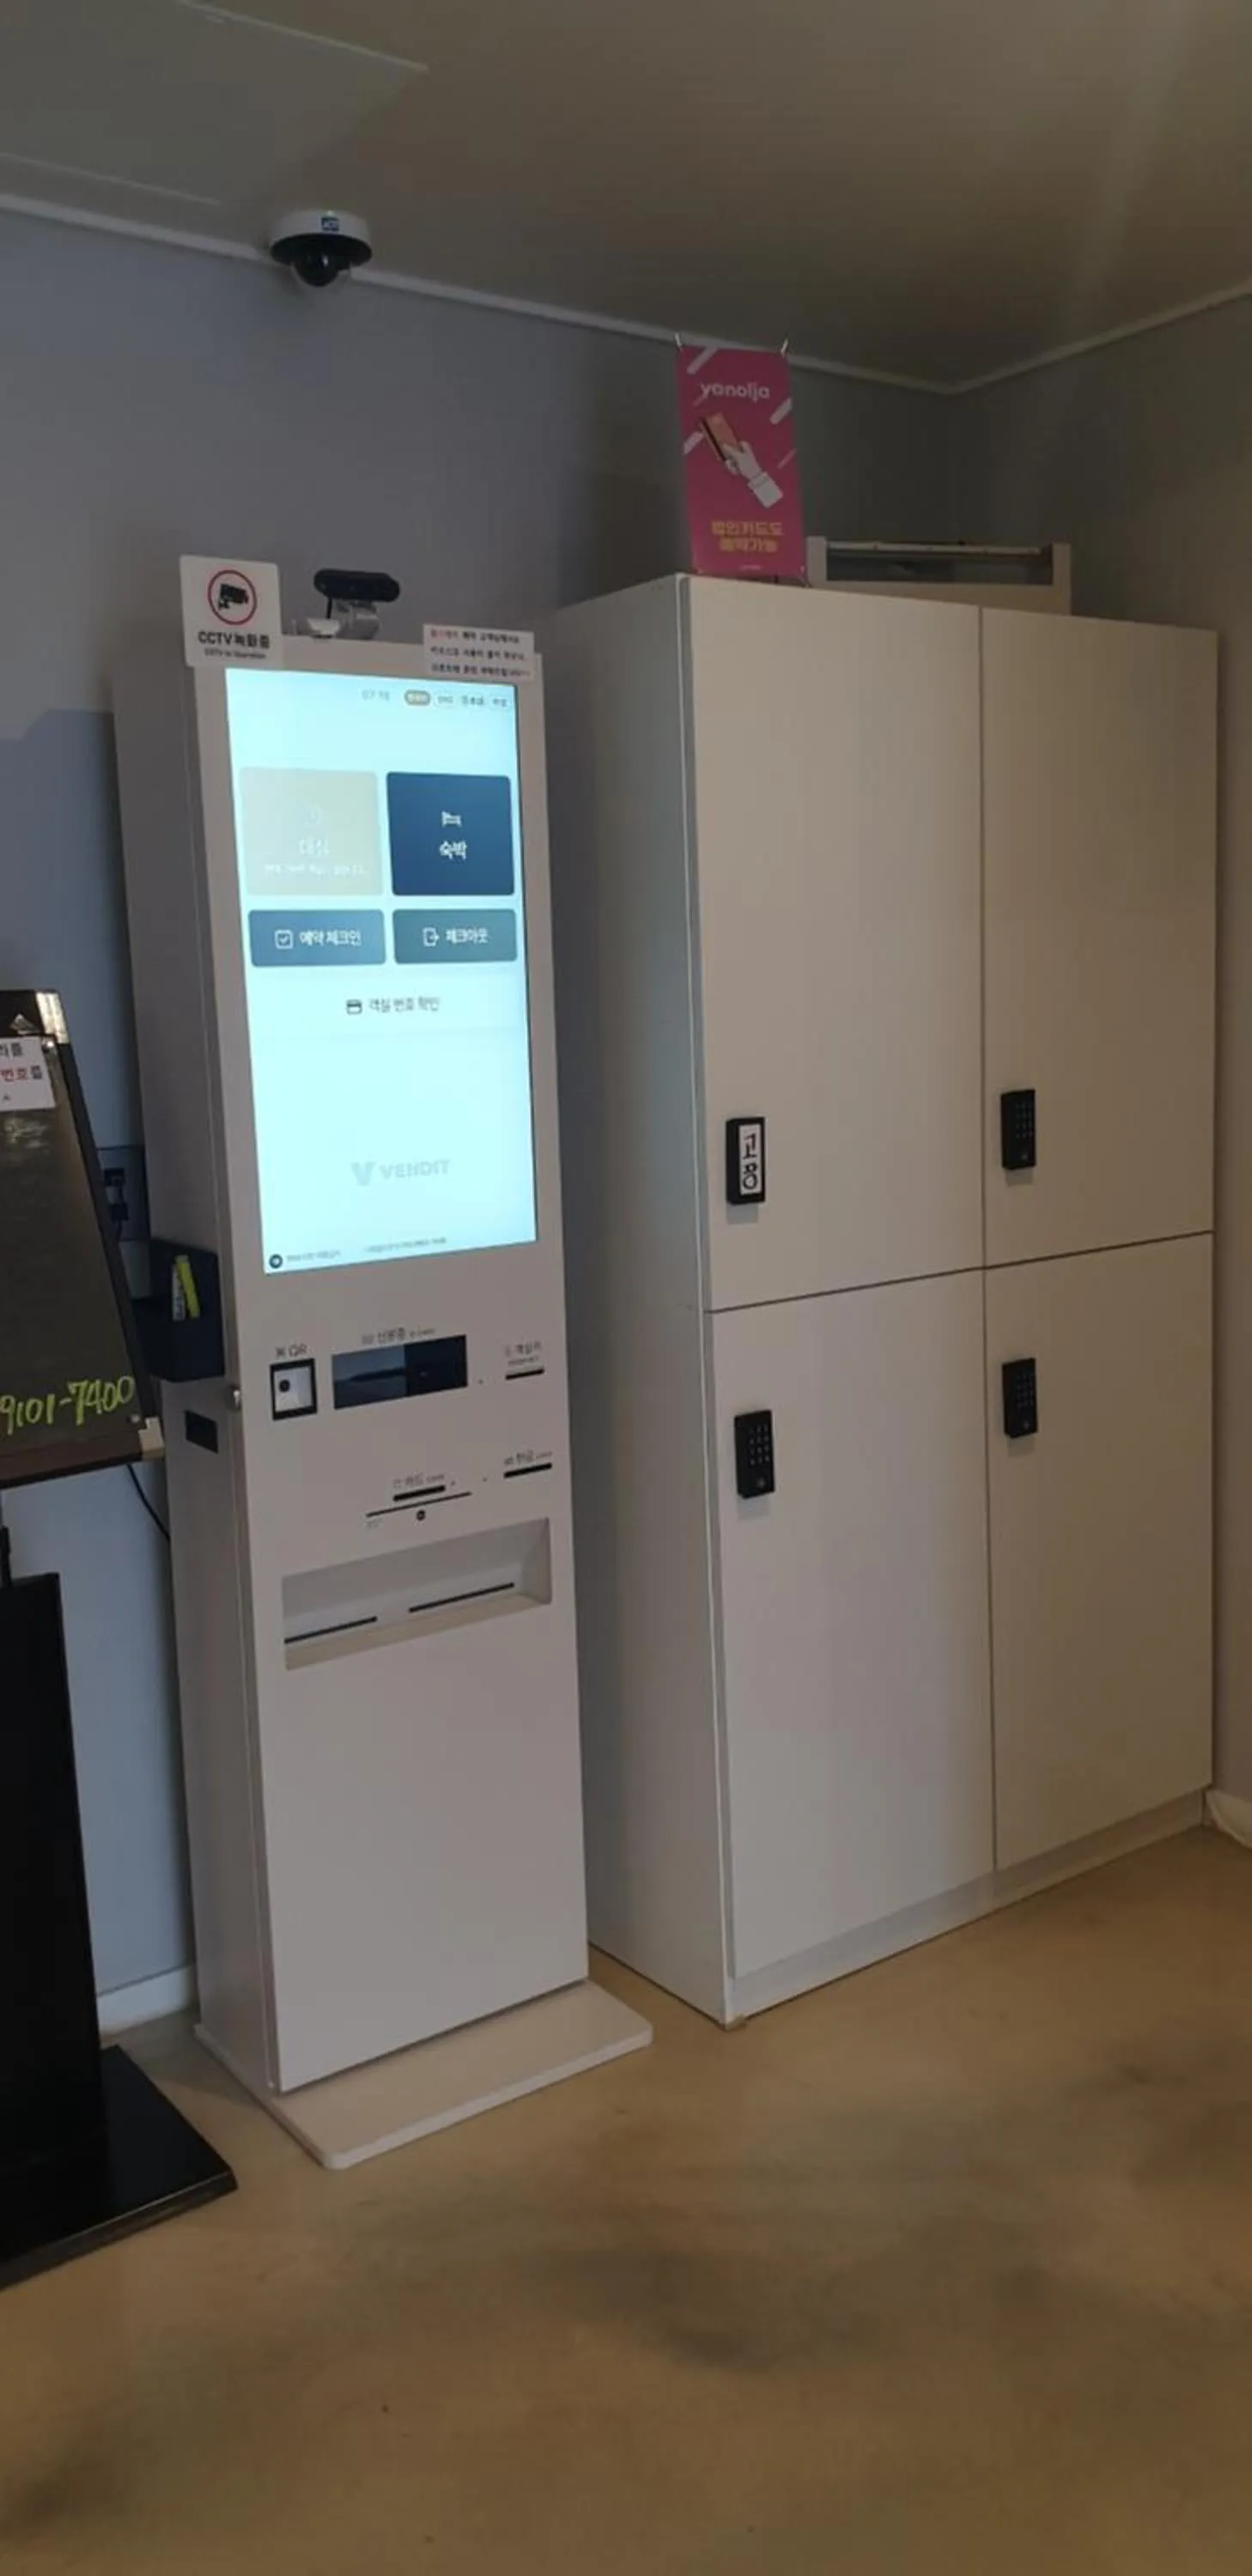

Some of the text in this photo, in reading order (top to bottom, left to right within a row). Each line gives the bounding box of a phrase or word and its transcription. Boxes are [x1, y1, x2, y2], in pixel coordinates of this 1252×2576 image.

[700, 383, 771, 403] yanolja
[711, 519, 785, 536] 법인카드도
[439, 840, 467, 860] 숙박
[299, 929, 362, 946] 예약 체크인
[445, 927, 489, 945] 체크아웃
[0, 1065, 43, 1082] 번호를
[380, 1158, 451, 1179] VENDIT
[742, 1133, 758, 1189] 고장
[0, 1376, 135, 1437] 9101-7400
